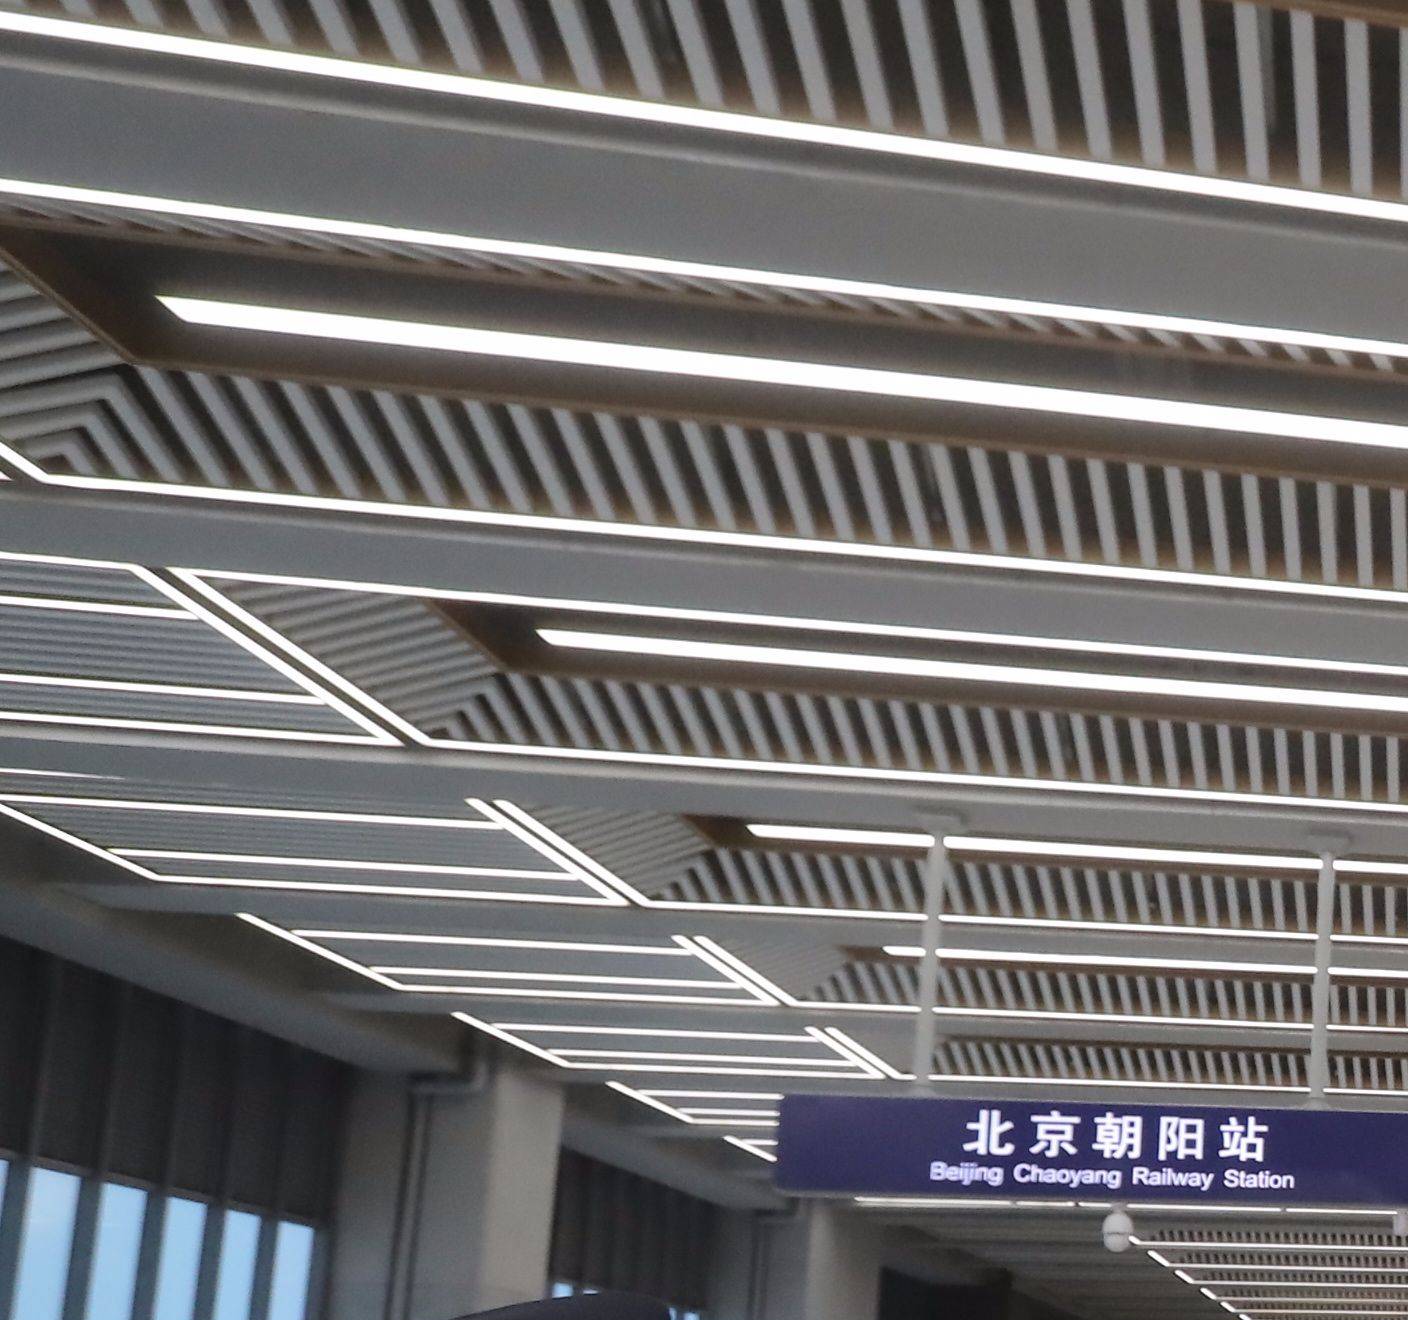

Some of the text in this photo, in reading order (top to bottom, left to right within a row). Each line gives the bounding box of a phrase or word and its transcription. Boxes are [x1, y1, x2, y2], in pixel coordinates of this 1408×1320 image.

[962, 1109, 1268, 1162] 北京朝阳站
[930, 1161, 1295, 1191] Beijing Chaoyang Railway Station
